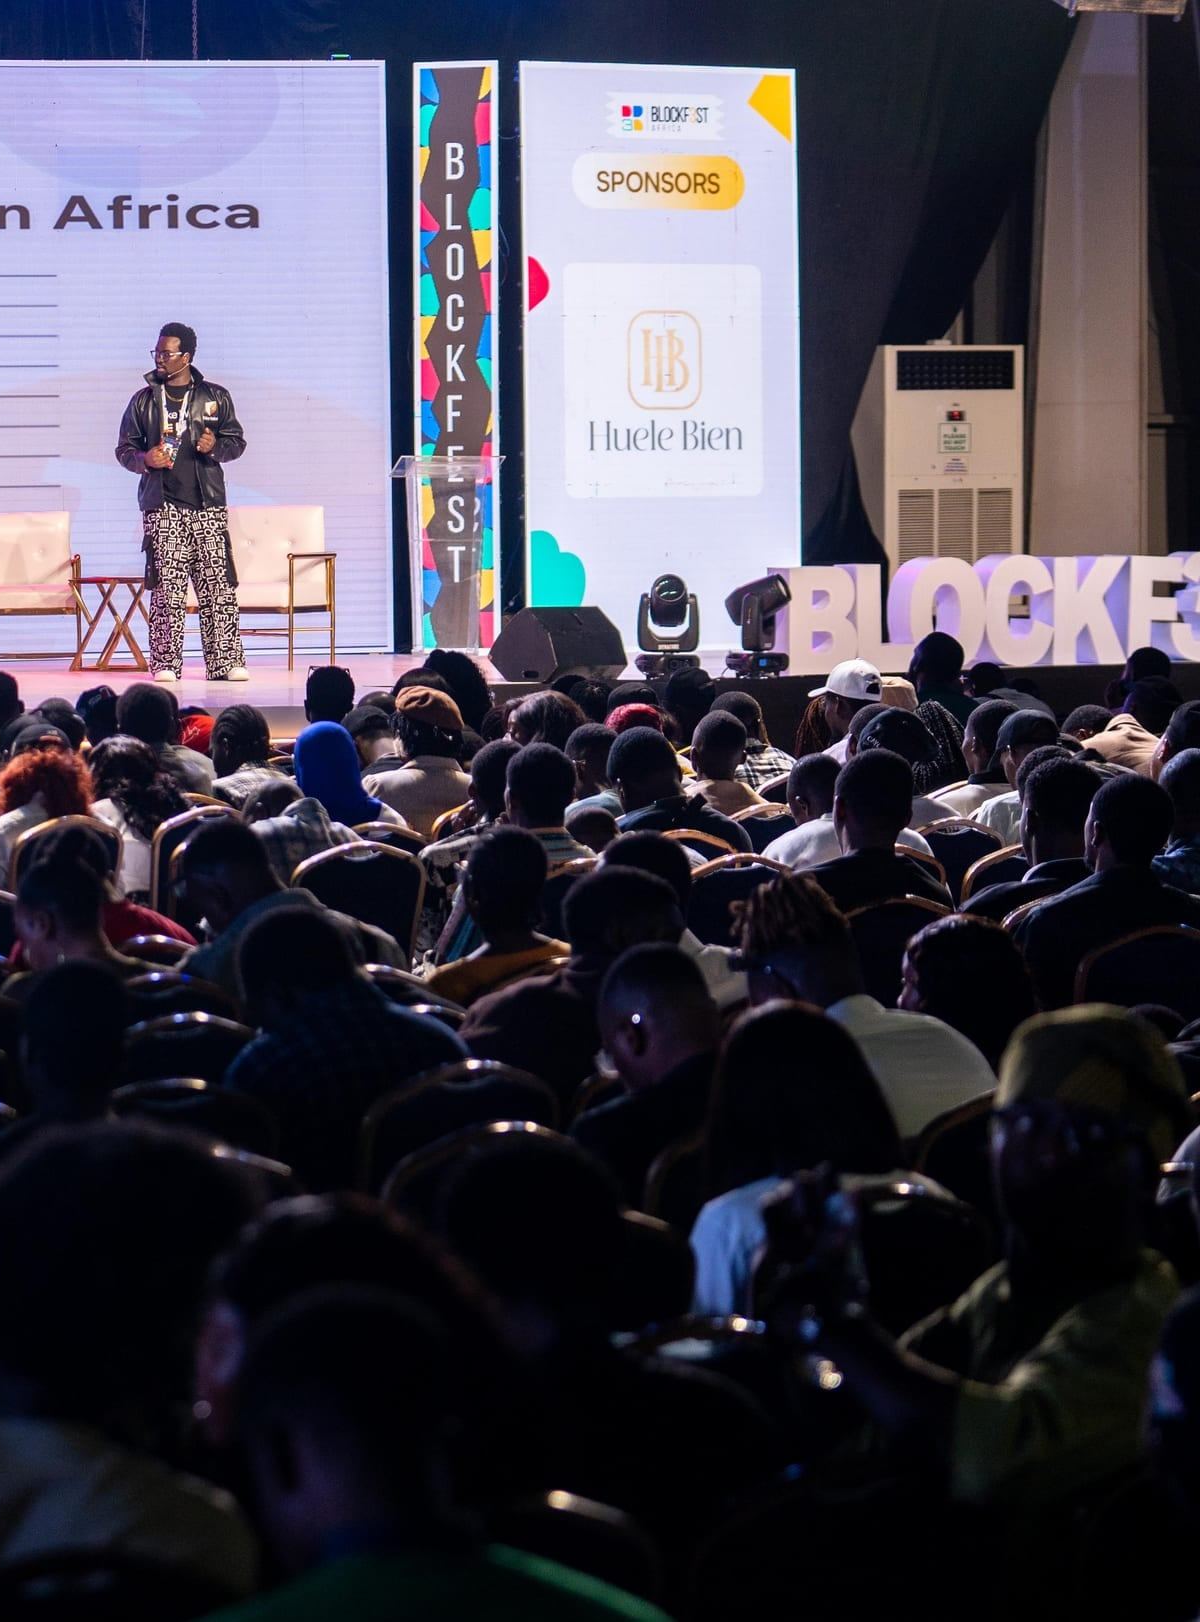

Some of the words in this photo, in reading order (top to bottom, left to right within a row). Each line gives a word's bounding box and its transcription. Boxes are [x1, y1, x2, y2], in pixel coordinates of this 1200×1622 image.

[597, 171, 721, 194] SPONSORS
[52, 194, 260, 230] Africa
[589, 420, 674, 452] Huele
[682, 420, 743, 451] Bien
